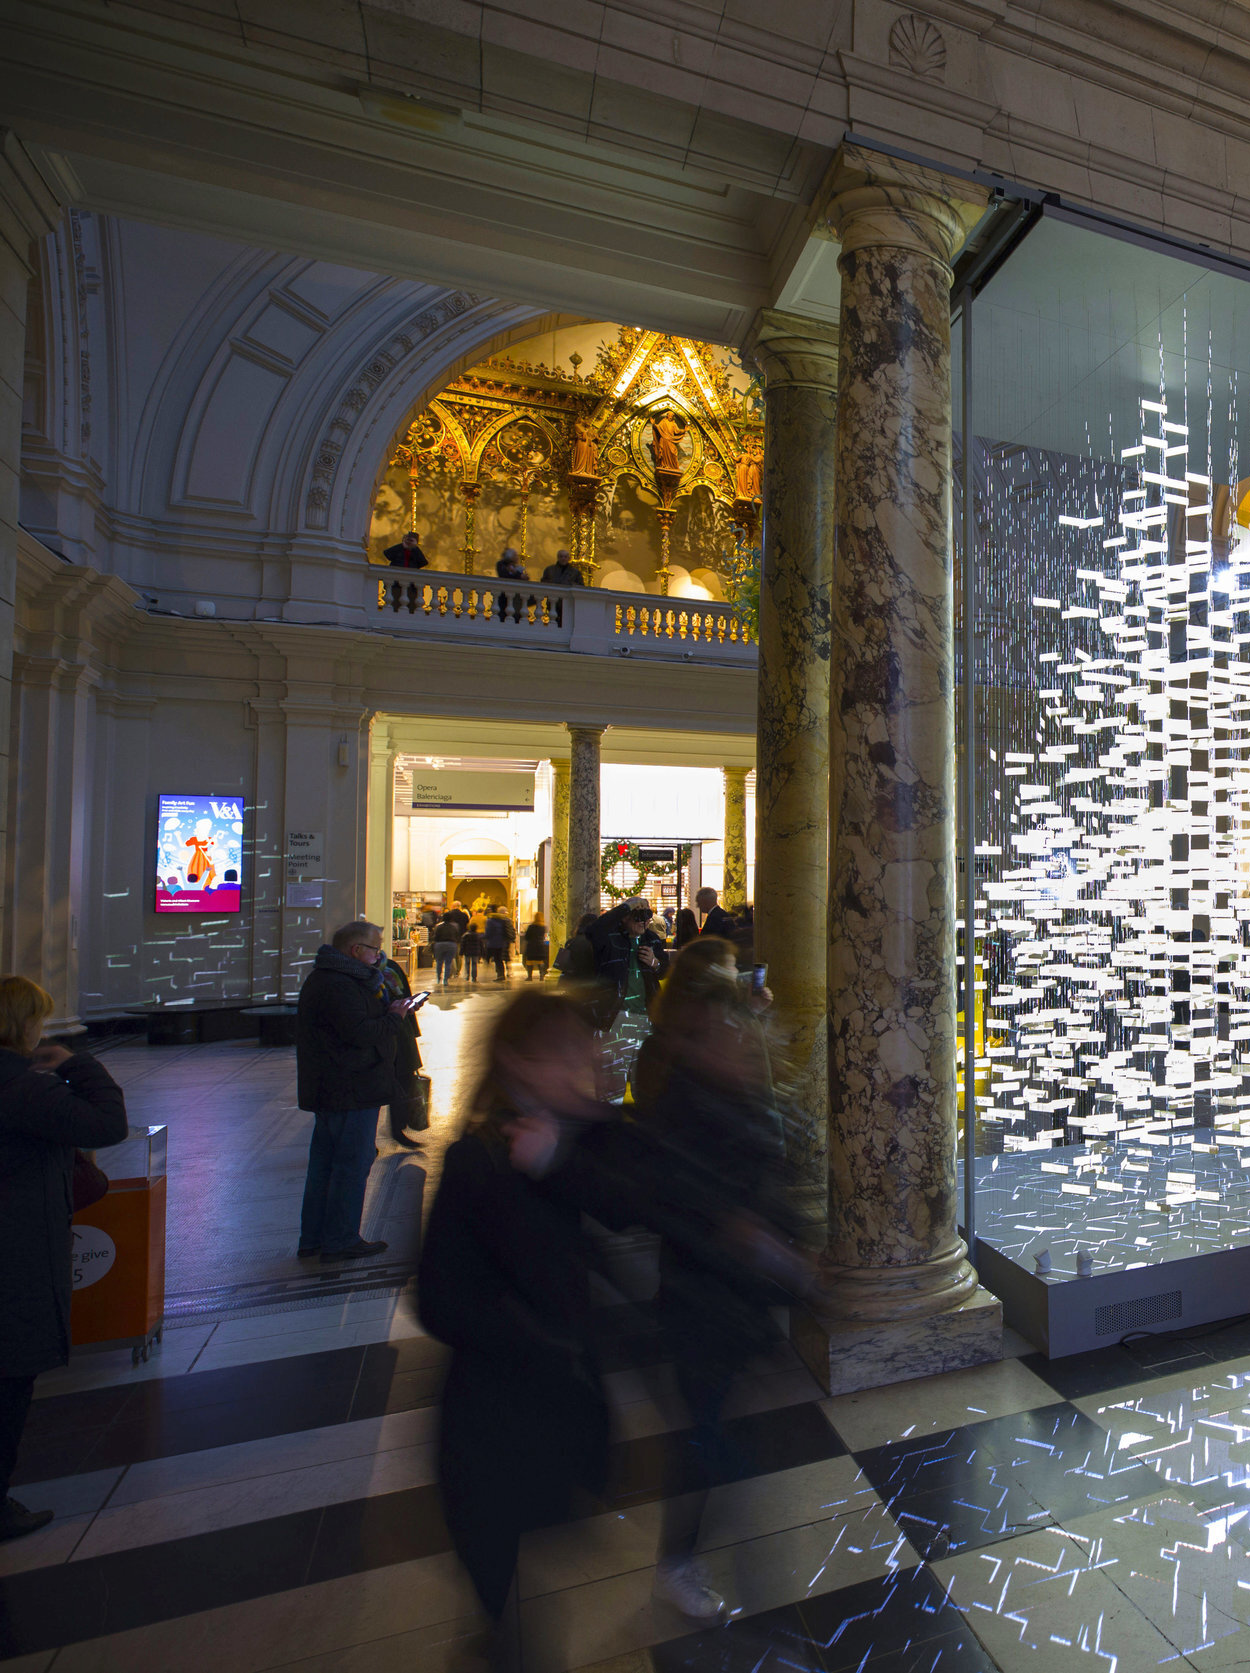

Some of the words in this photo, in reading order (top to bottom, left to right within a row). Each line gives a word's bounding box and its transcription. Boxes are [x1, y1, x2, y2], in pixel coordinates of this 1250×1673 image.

[416, 784, 438, 792] Opera
[416, 793, 452, 802] Balenciaga
[208, 801, 243, 820] V&A
[289, 832, 308, 840] Talks
[289, 839, 311, 847] Tours
[288, 854, 321, 863] Meeting
[81, 1249, 110, 1264] give
